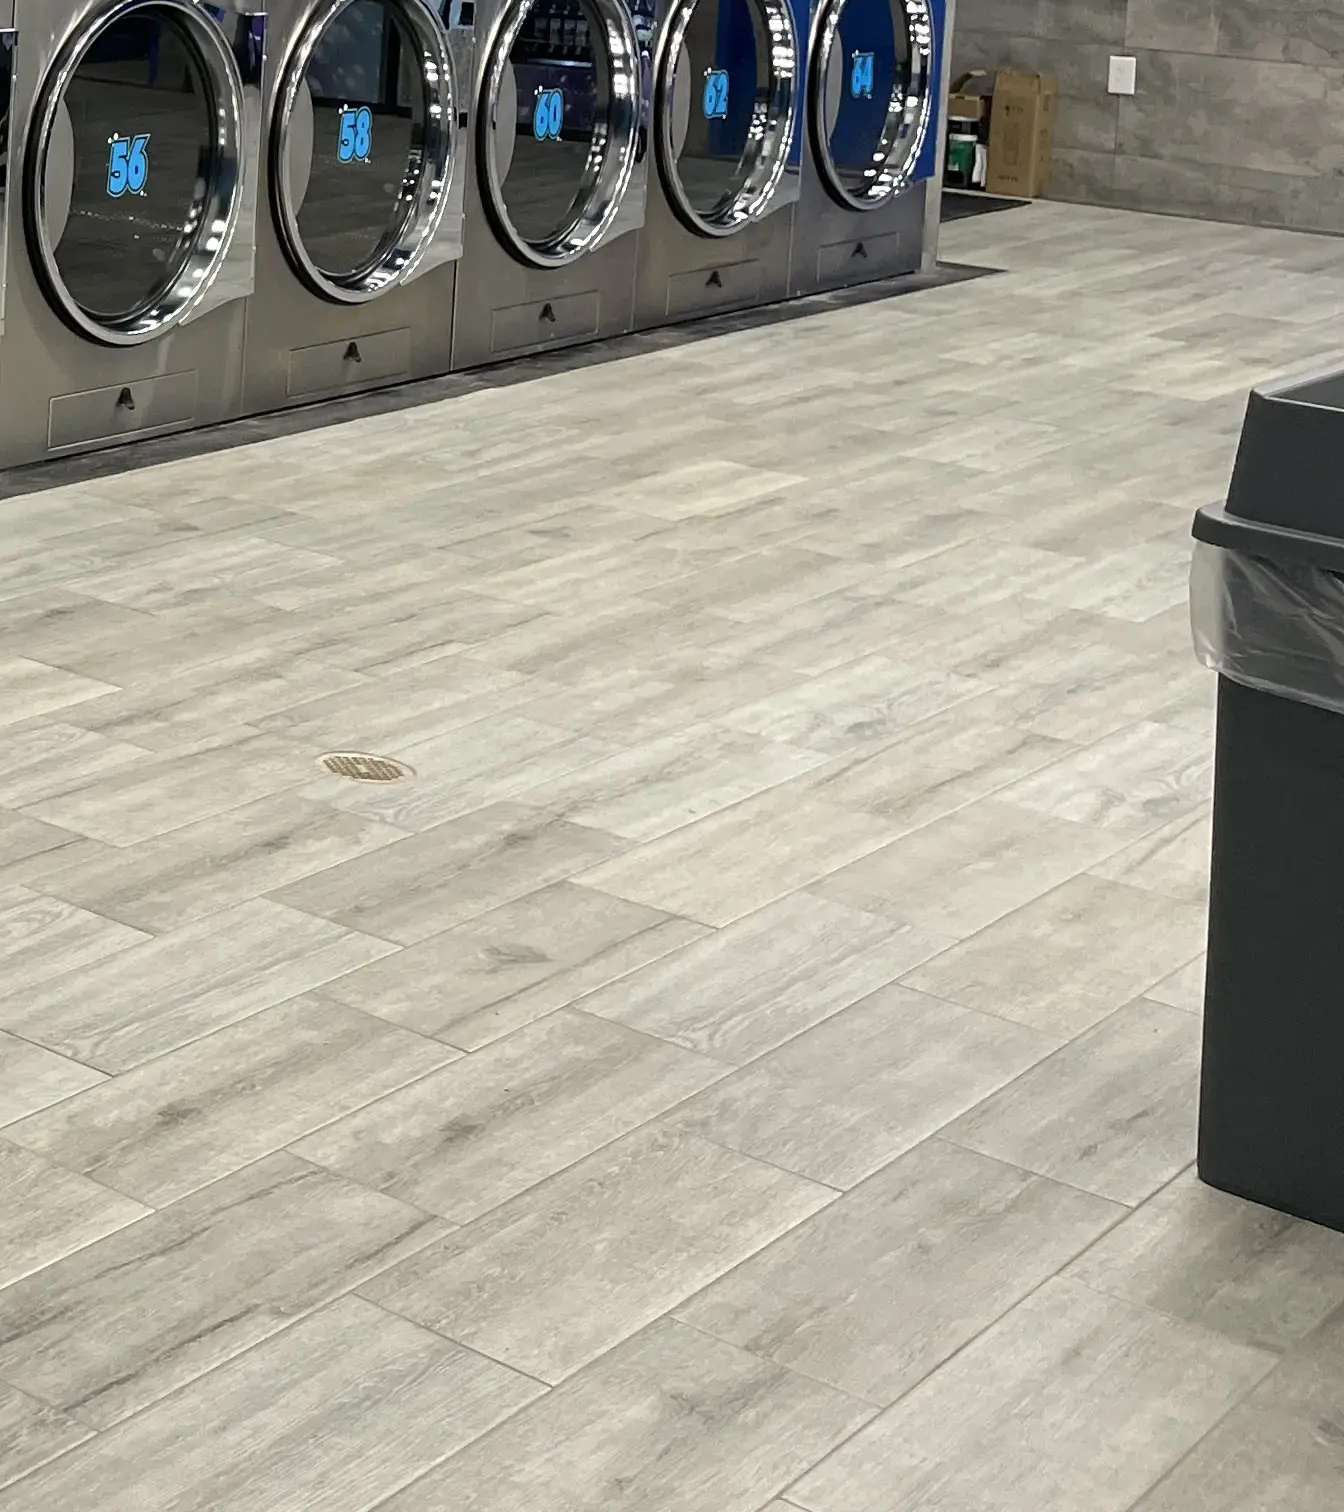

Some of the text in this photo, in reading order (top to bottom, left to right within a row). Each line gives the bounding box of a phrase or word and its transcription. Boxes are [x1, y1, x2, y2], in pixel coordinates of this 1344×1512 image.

[337, 108, 372, 162] 58
[533, 90, 564, 139] 60
[106, 136, 149, 196] 56
